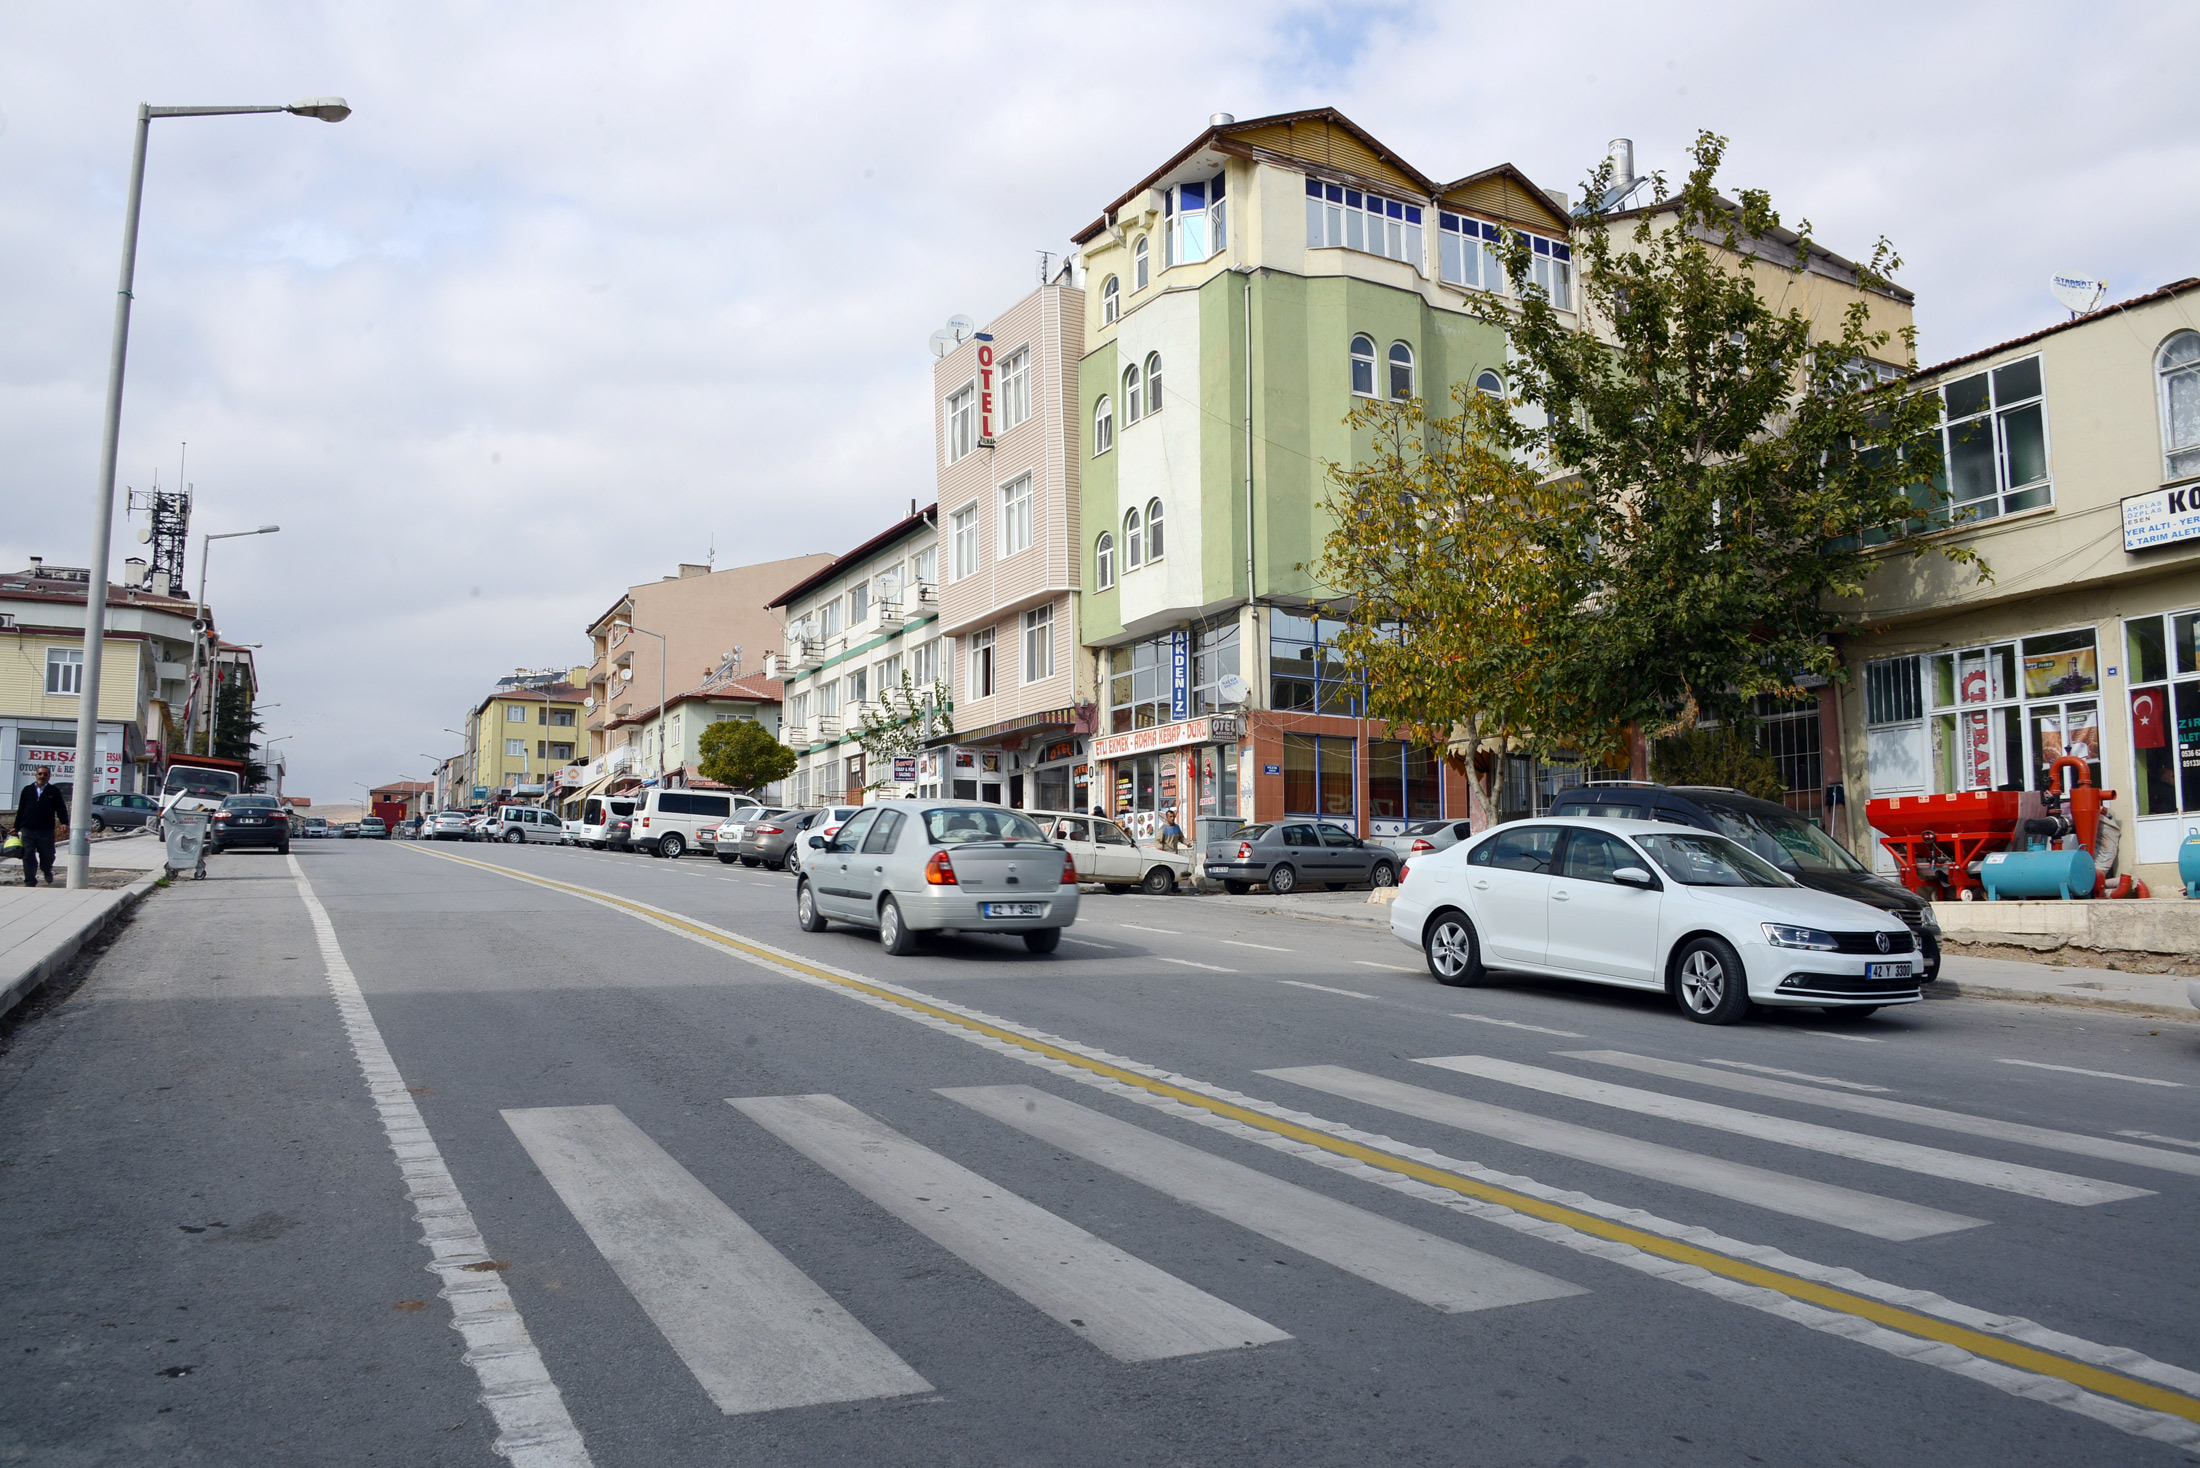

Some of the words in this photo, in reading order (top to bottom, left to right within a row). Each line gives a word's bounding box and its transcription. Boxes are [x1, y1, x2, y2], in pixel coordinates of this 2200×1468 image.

[2054, 277, 2094, 286] STARSAT
[979, 346, 992, 436] OTEL
[2126, 527, 2145, 536] YER
[2149, 522, 2170, 532] ALTI
[2180, 516, 2200, 525] YER
[2137, 533, 2168, 544] TARIM
[1175, 633, 1184, 711] AKDENİZ
[1213, 720, 1236, 731] OTEL
[1109, 736, 1129, 752] EKMEK
[1134, 731, 1157, 749] ADANA
[1159, 725, 1180, 745] KEBAP
[1187, 720, 1206, 739] DÜRÜ
[28, 750, 77, 764] ERŞA
[1050, 743, 1072, 760] OTEL
[2182, 750, 2194, 758] 0536
[1873, 964, 1883, 977] 42
[1885, 964, 1891, 977] Y
[1895, 964, 1910, 977] 3300
